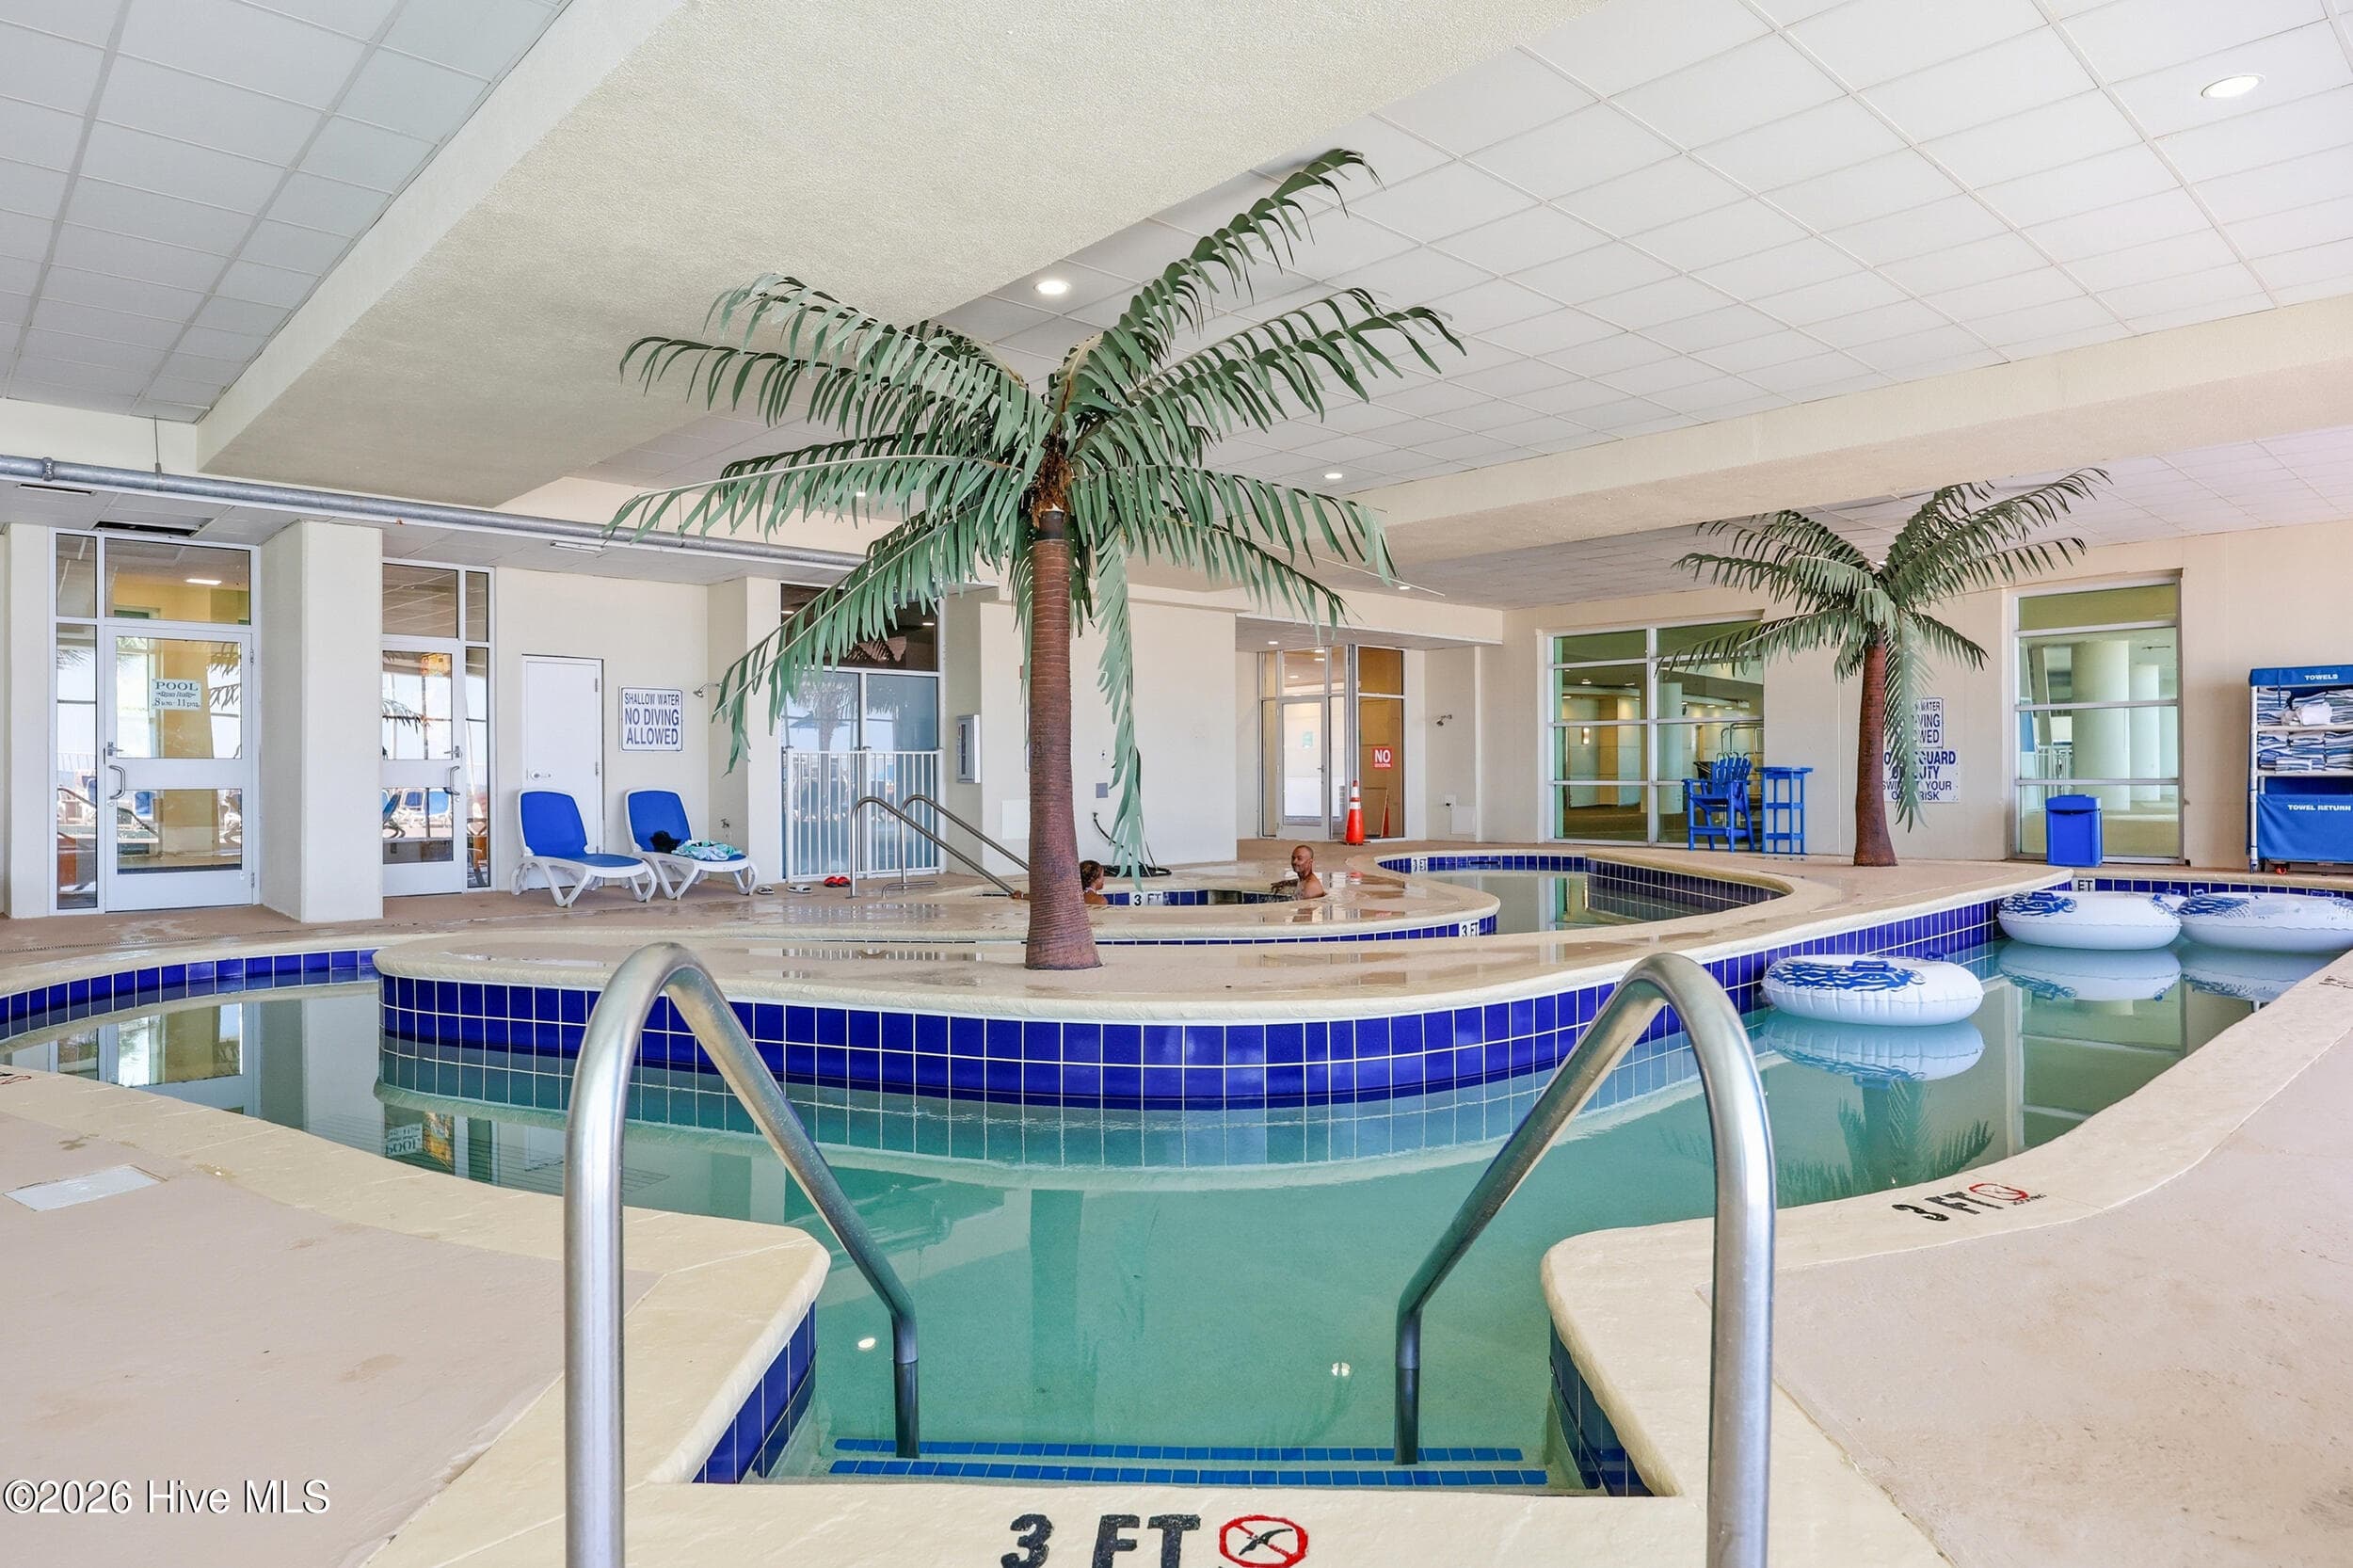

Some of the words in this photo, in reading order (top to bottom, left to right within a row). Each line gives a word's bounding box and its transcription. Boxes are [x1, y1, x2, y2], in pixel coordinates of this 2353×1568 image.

[156, 681, 200, 692] POOL
[625, 692, 656, 706] SHALLOW
[658, 694, 680, 706] WATER
[625, 707, 640, 726] NO
[644, 708, 680, 727] DIVING
[626, 728, 679, 745] ALLOWED
[1374, 749, 1391, 763] NO
[1134, 894, 1142, 906] 3
[1147, 893, 1162, 905] FT
[1462, 924, 1468, 937] 3
[1891, 1203, 1951, 1223] 3
[1924, 1191, 2005, 1216] FT
[1000, 1513, 1054, 1568] 3
[1092, 1513, 1201, 1568] FT
